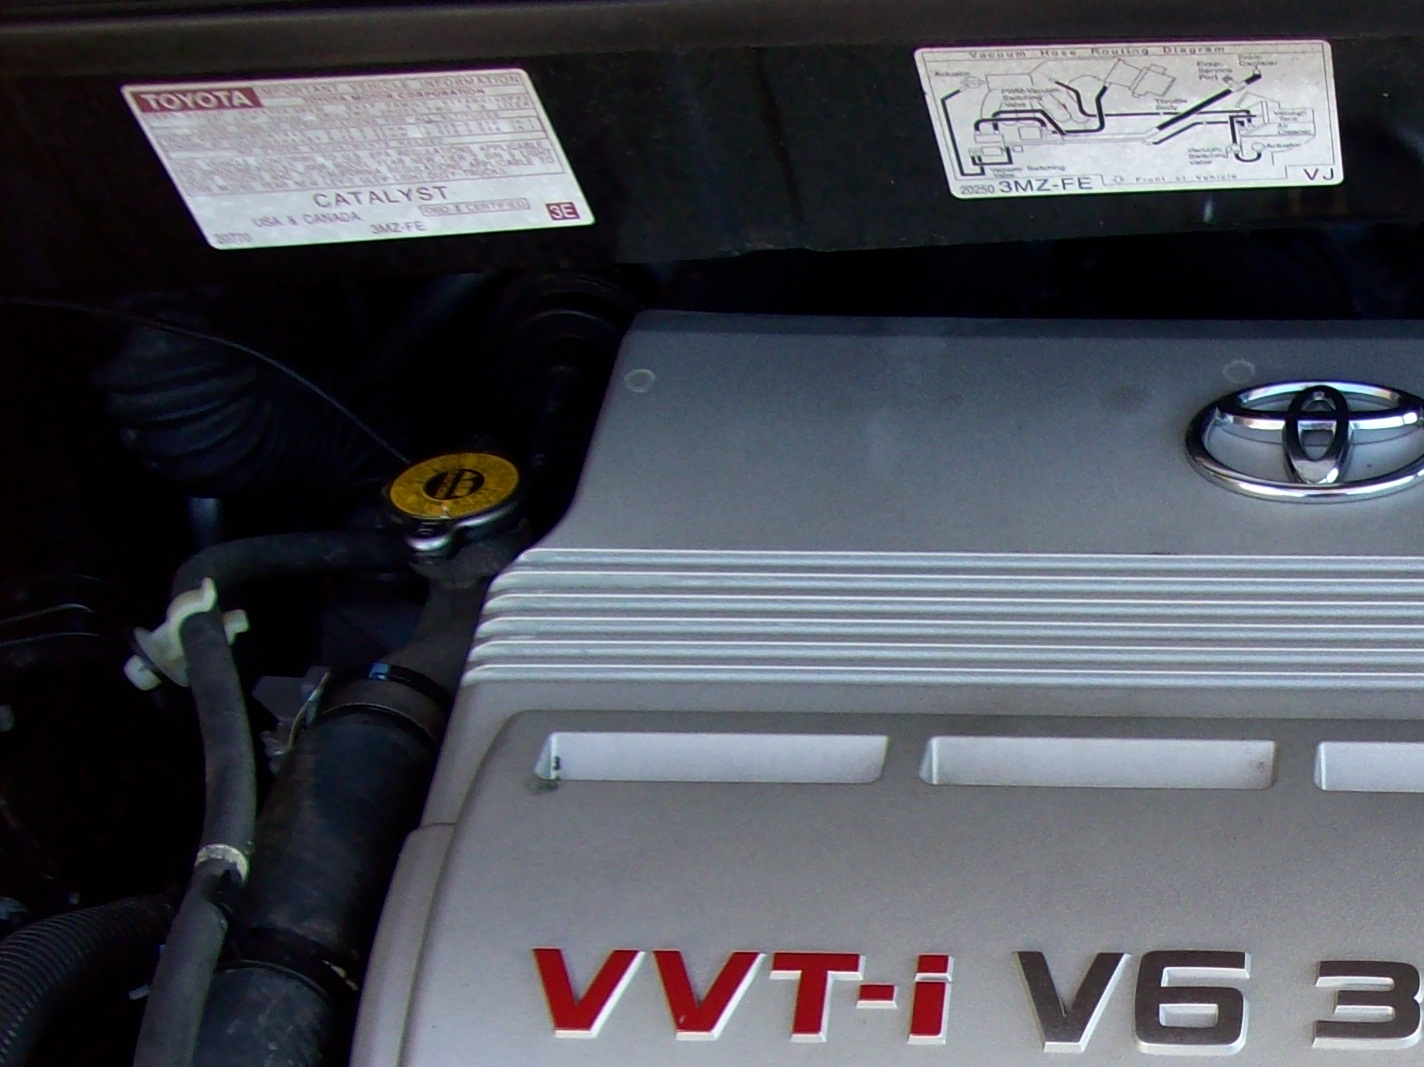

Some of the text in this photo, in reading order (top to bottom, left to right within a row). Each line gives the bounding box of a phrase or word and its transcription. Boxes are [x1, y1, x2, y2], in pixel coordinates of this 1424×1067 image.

[968, 46, 1225, 59] Vacuum Hose Routing Diagram
[417, 74, 520, 88] INFORMATION
[140, 90, 254, 111] TOYOTA
[396, 87, 486, 99] CORPORATION
[960, 177, 1093, 195] 20250 3MZ-FE
[313, 185, 449, 208] CATALYST
[253, 216, 283, 228] USA
[303, 212, 361, 225] CANADA
[549, 204, 578, 220] 3E
[370, 221, 426, 235] 3MZ-FE
[533, 947, 954, 1044] VVT-i
[1015, 949, 1251, 1054] V6
